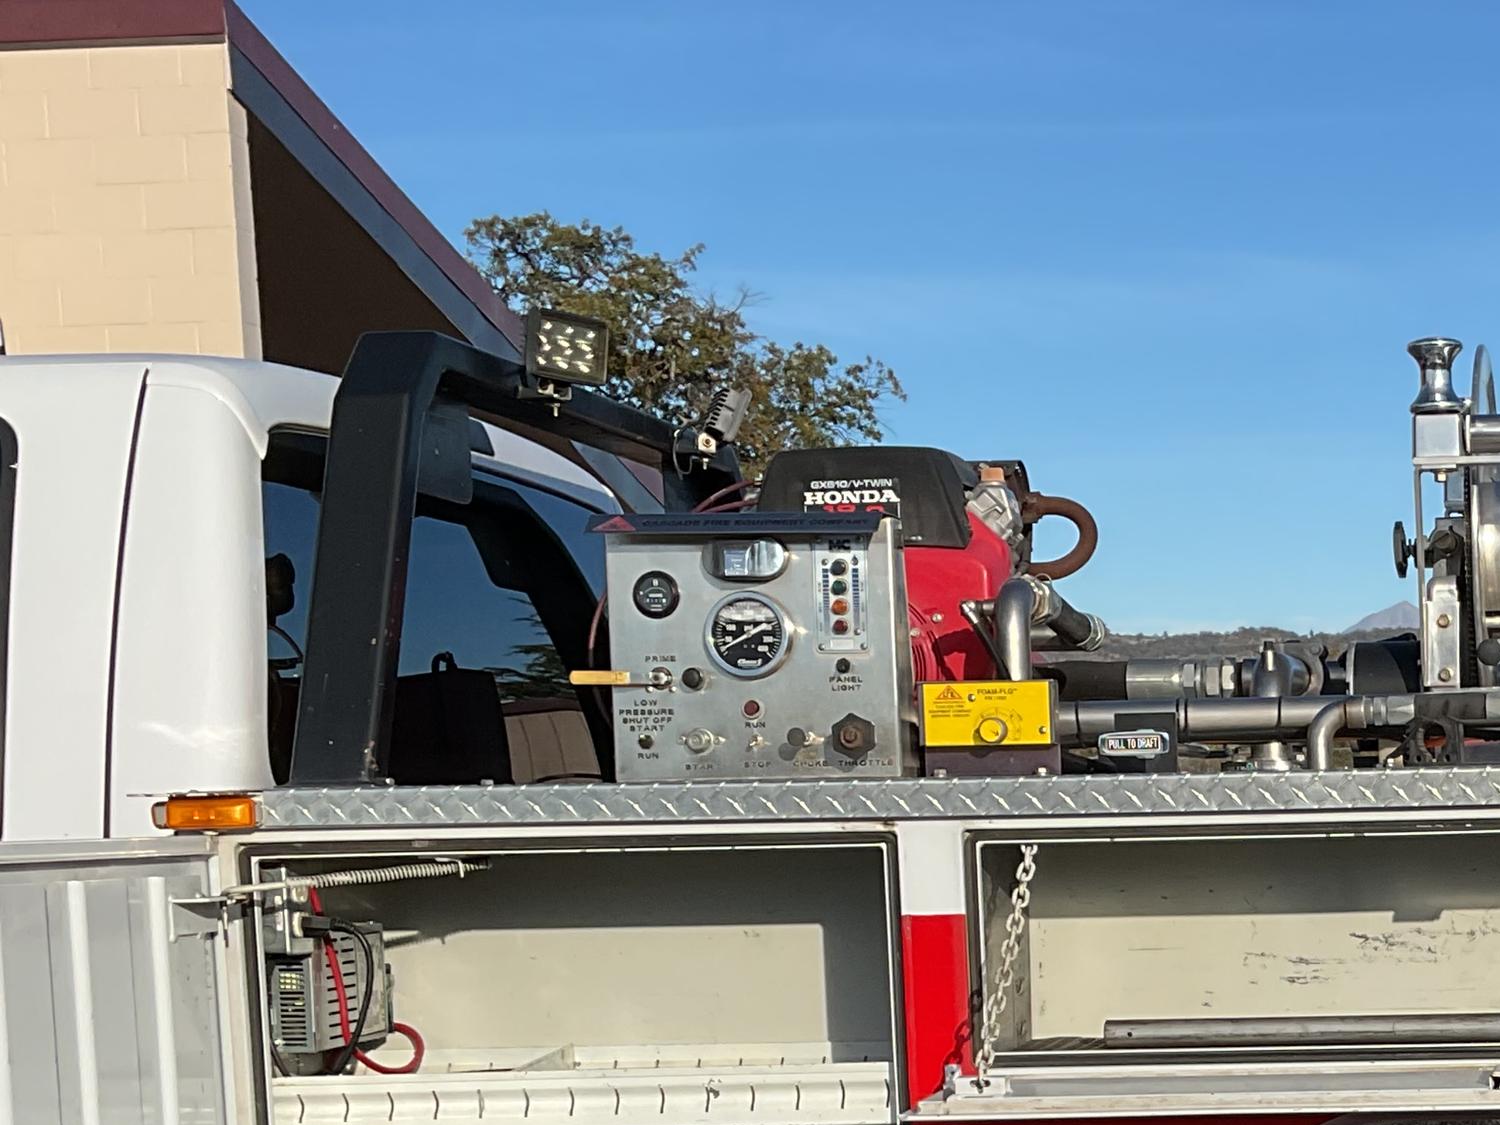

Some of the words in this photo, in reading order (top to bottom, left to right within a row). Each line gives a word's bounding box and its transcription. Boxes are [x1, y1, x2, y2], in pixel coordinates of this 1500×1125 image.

[804, 489, 900, 505] HONDA
[622, 717, 649, 725] SHUT
[1108, 739, 1126, 750] PULL
[1127, 738, 1136, 749] TO
[1137, 737, 1158, 748] DRAFT
[838, 759, 893, 767] THROTTLE
